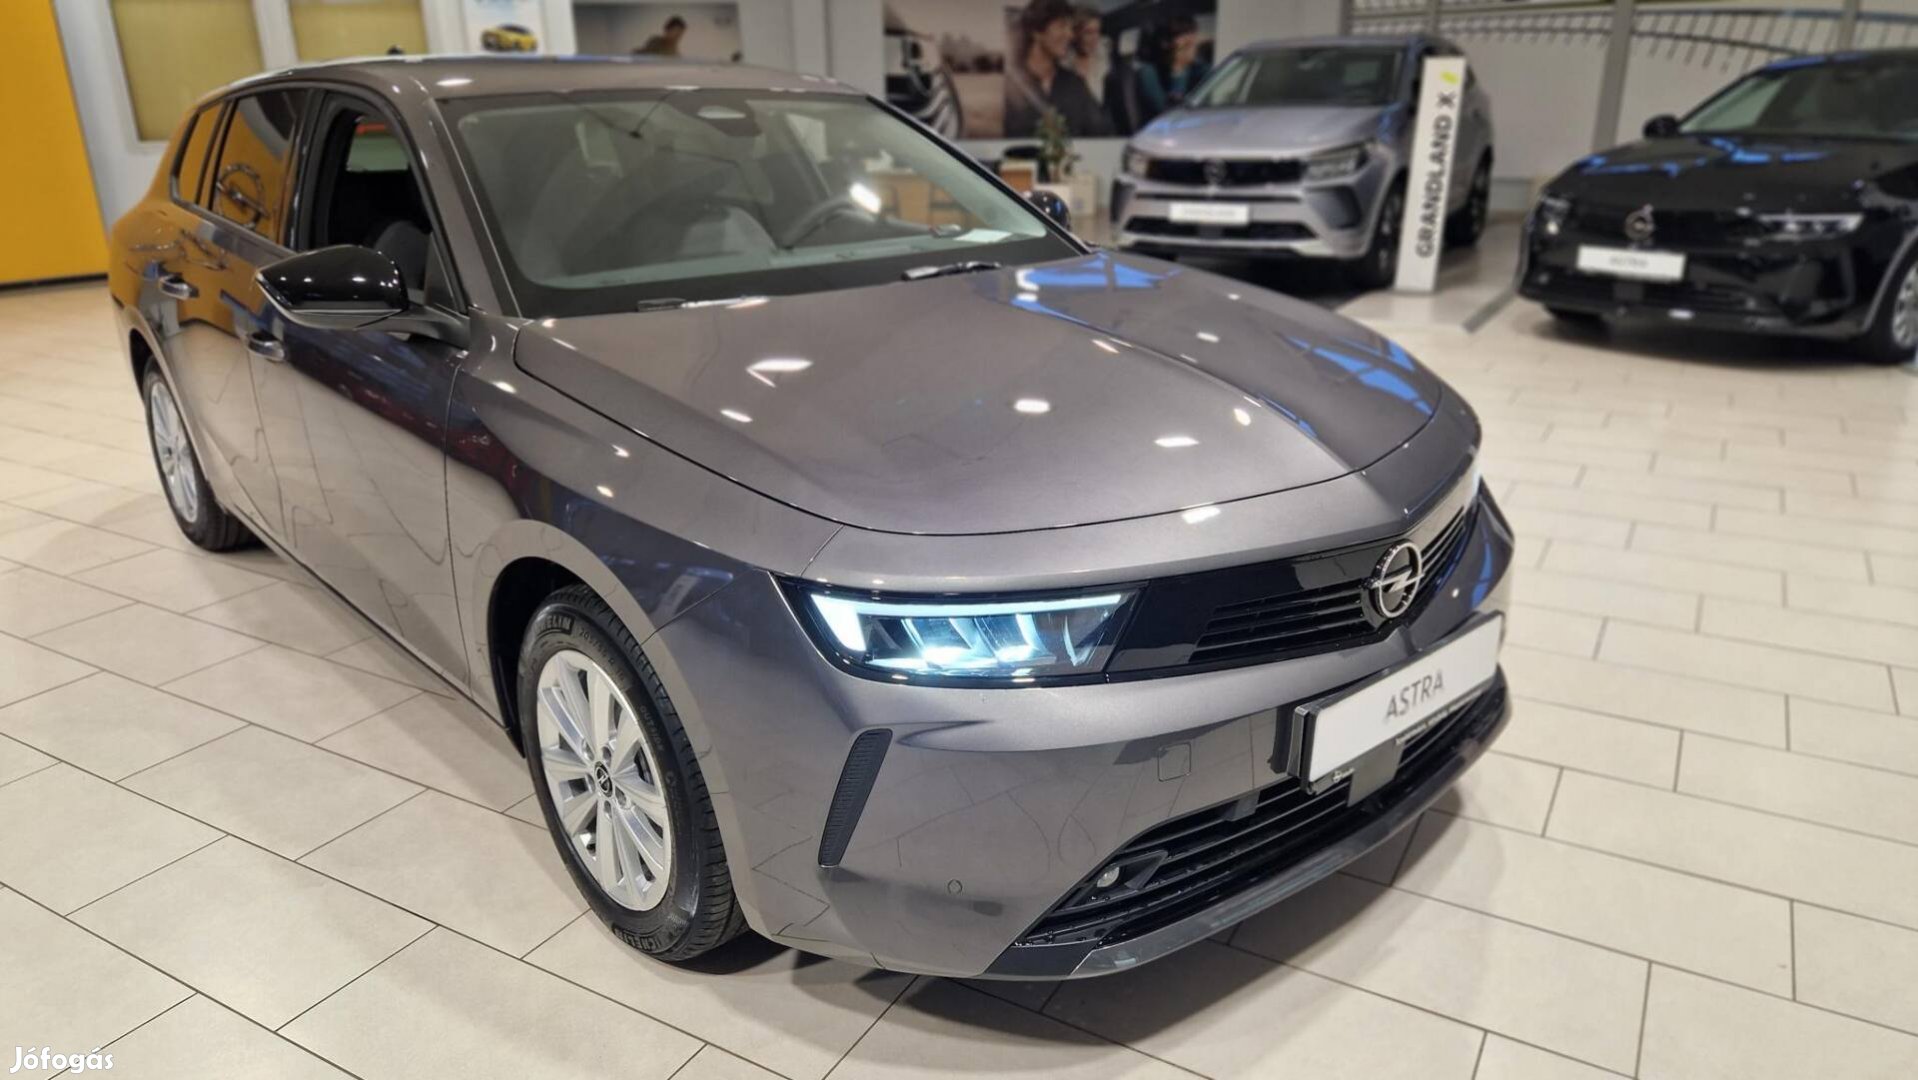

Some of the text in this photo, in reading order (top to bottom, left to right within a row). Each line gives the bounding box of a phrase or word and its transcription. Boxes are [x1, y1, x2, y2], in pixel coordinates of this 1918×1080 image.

[1415, 91, 1456, 258] GRANDLAND X
[1384, 670, 1445, 721] ASTRA
